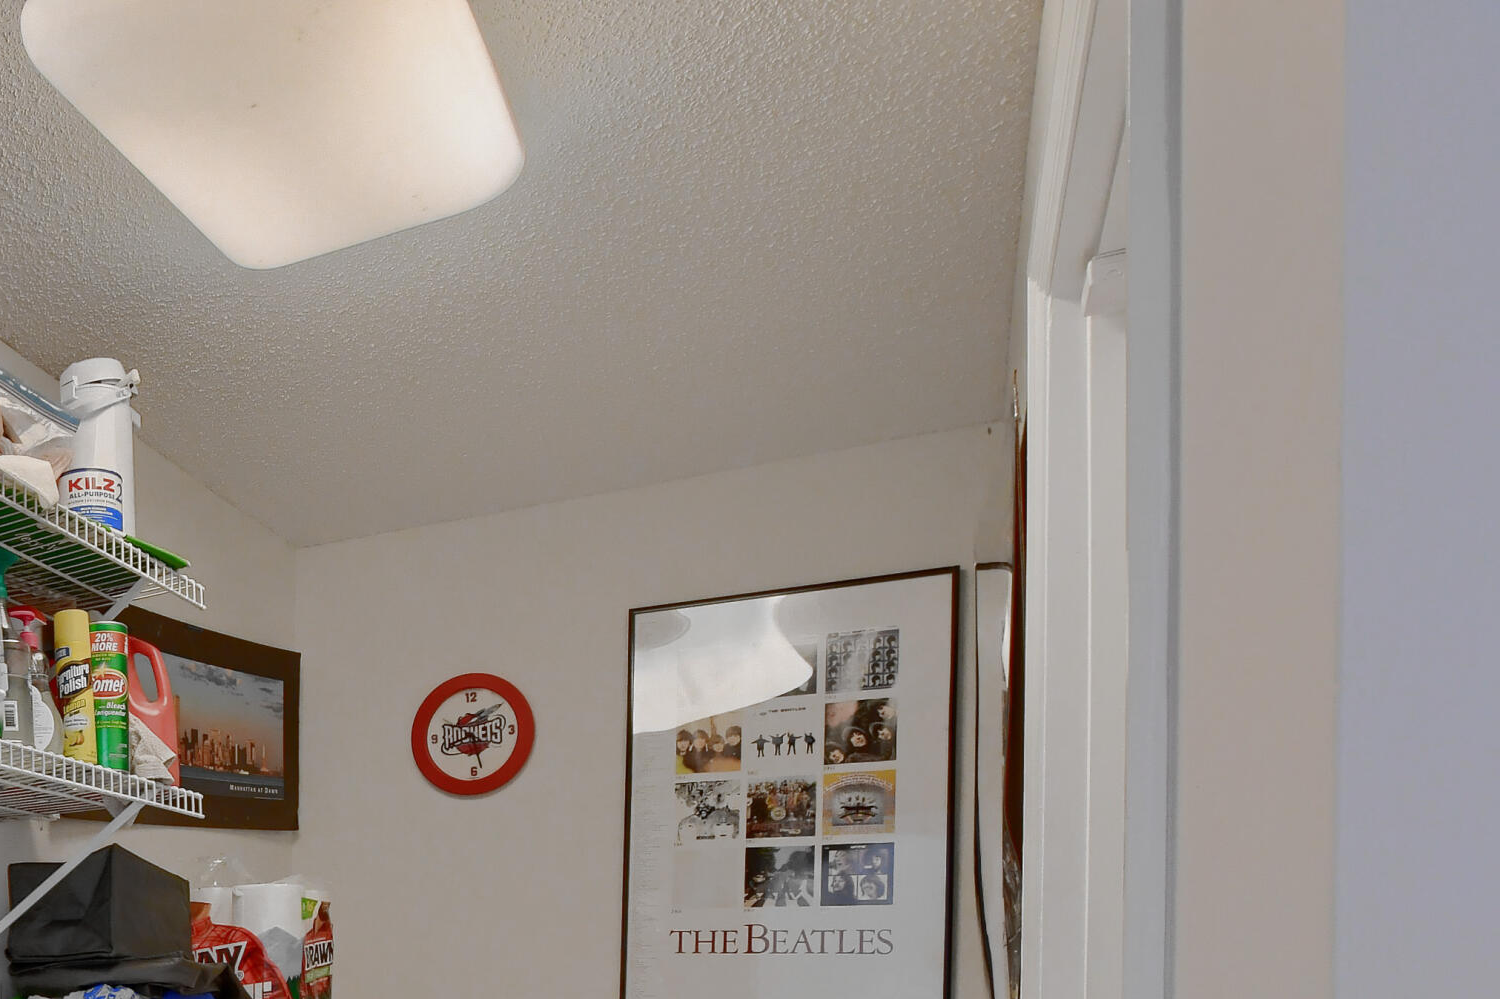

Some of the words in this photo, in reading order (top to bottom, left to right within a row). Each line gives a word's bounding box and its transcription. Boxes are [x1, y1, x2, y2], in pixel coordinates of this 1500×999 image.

[68, 477, 115, 492] KILZ
[95, 633, 114, 642] 20%
[92, 643, 118, 652] MORE
[59, 676, 87, 698] Polish
[465, 692, 477, 702] 12
[442, 717, 502, 750] ROCKETS
[508, 724, 515, 735] 3
[431, 734, 438, 744] 9
[470, 767, 478, 777] 6
[669, 929, 739, 955] THE
[743, 923, 894, 955] BEATLES
